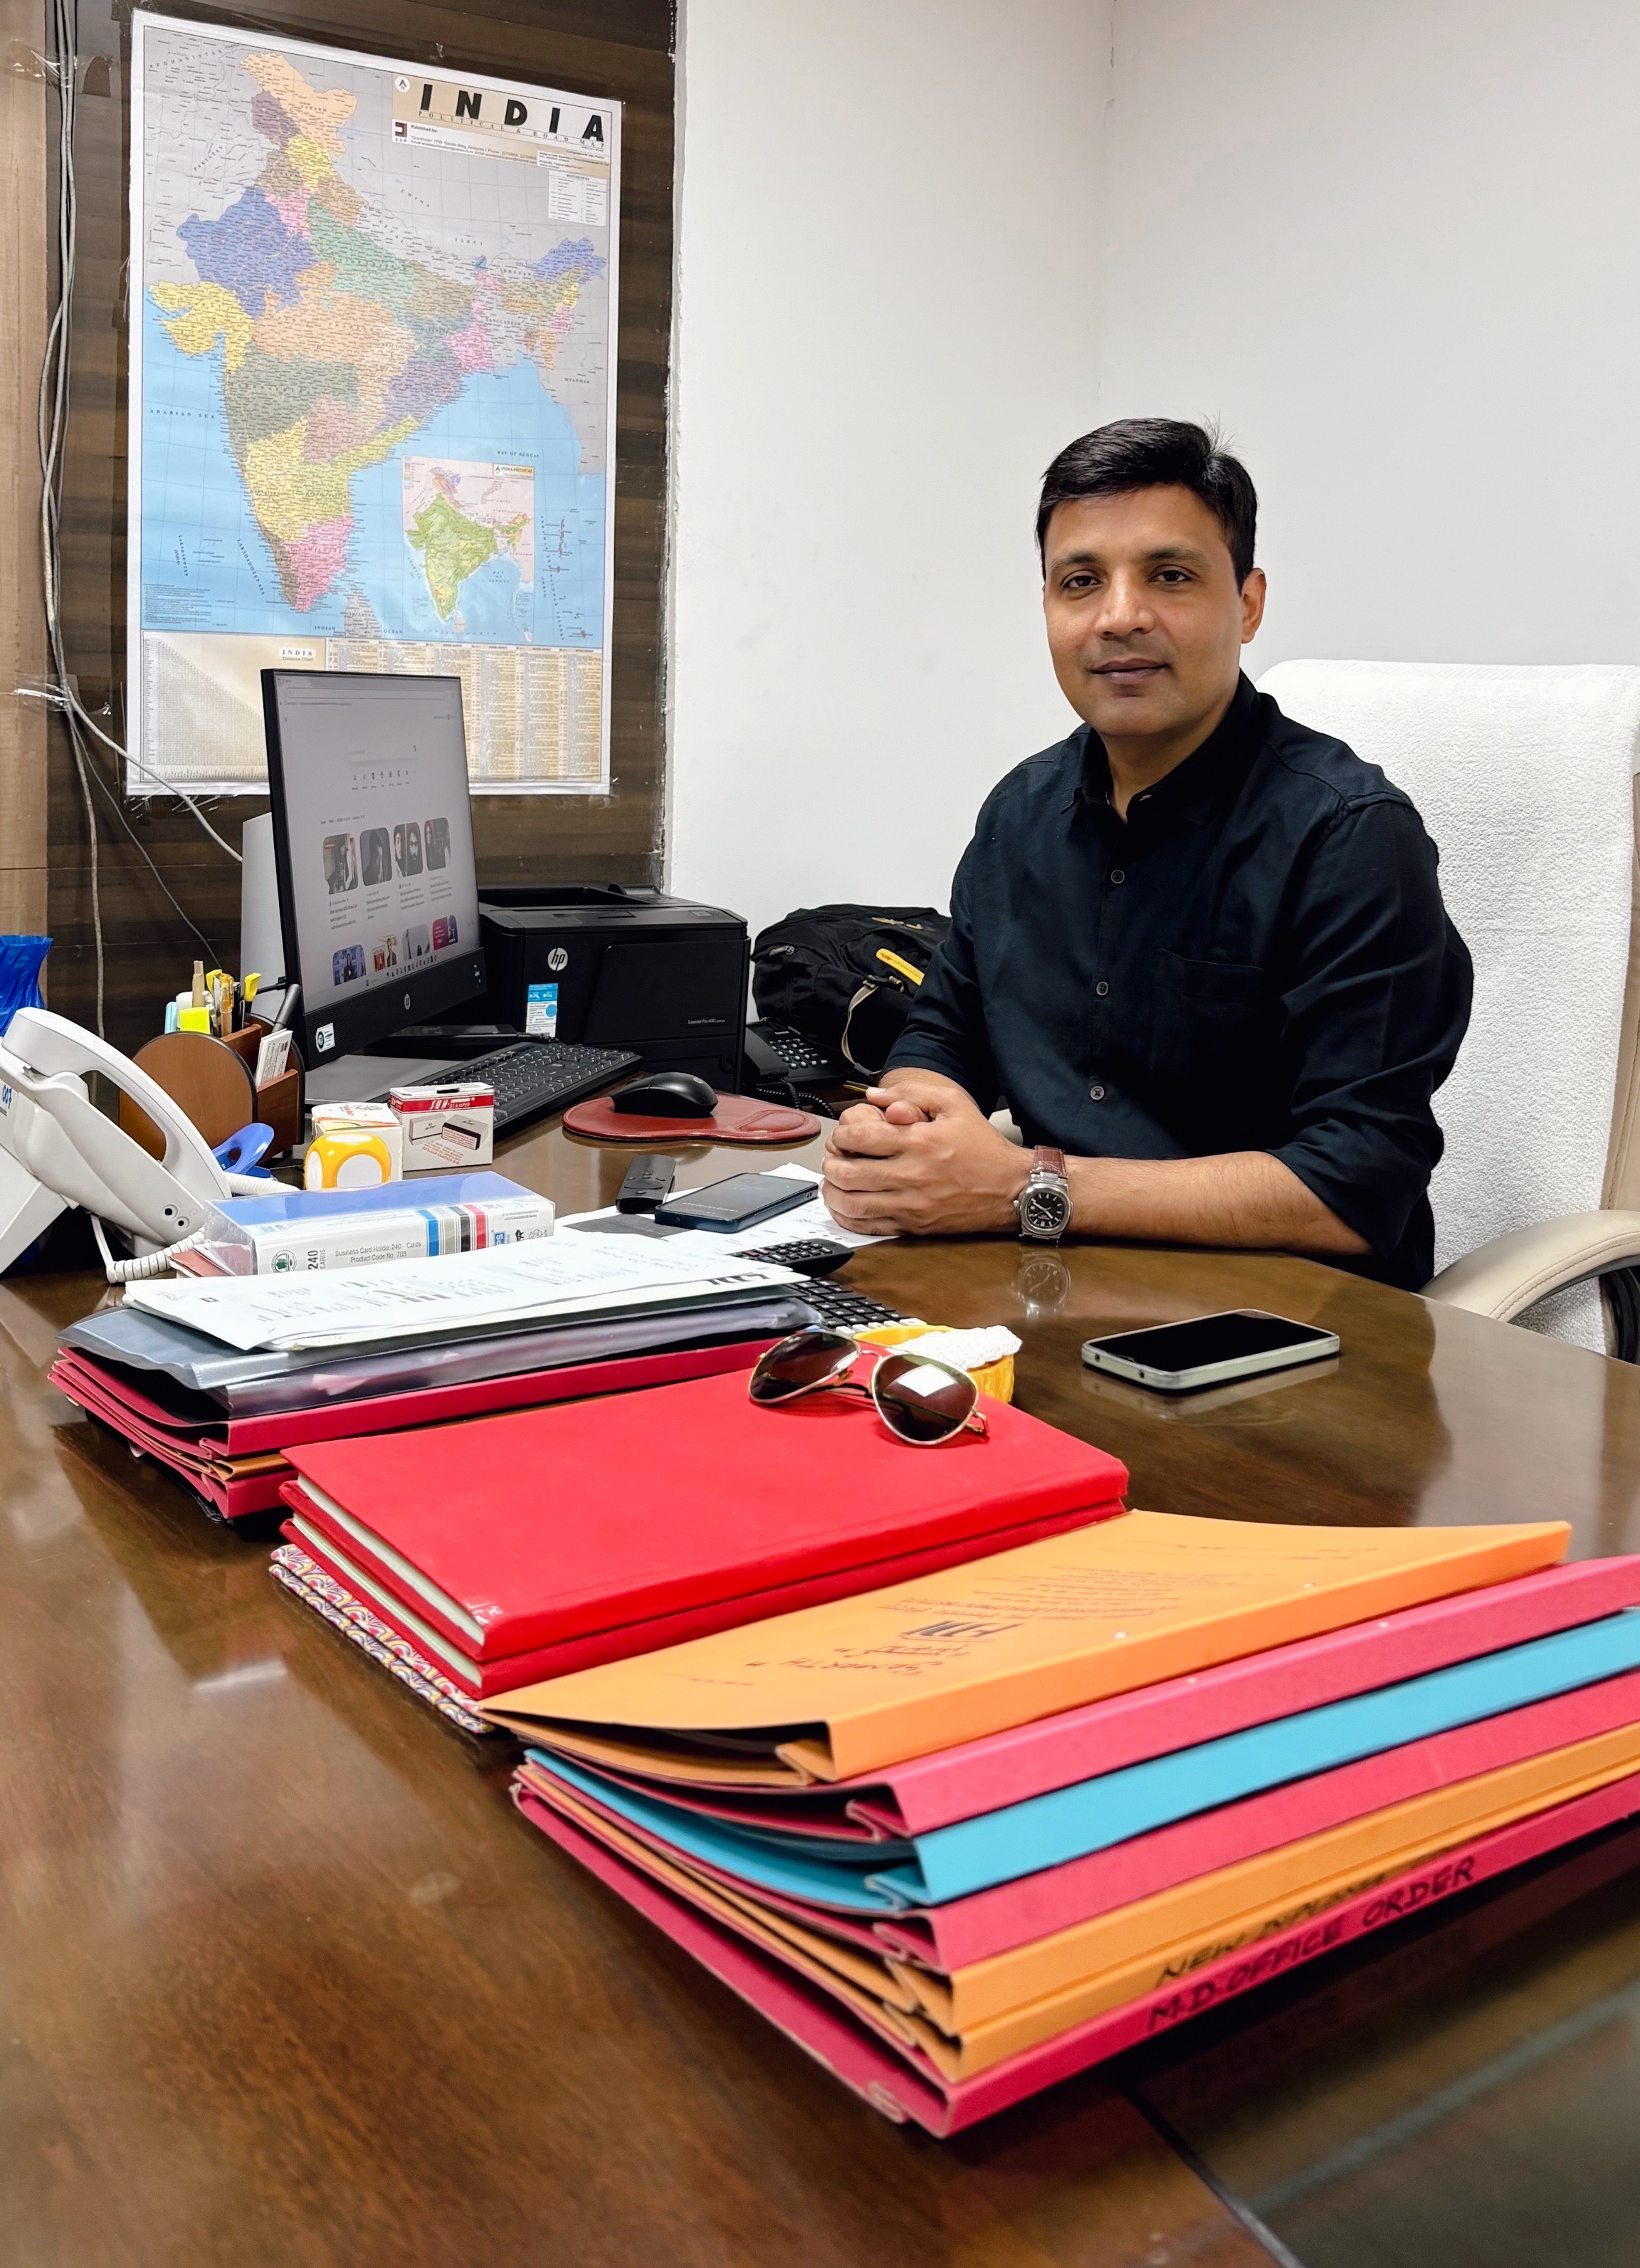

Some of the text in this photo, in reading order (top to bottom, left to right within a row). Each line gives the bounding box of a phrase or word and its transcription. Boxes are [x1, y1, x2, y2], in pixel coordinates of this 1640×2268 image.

[420, 83, 604, 142] INDIA
[419, 110, 504, 130] POLITICAL
[533, 130, 569, 142] ROAD
[551, 948, 567, 970] hp
[430, 1099, 448, 1110] SUN
[308, 1250, 319, 1270] 240
[335, 1249, 359, 1257] Business
[351, 1255, 371, 1264] Product
[1361, 1855, 1476, 1928] ORDER
[1155, 1931, 1246, 1990] NEW
